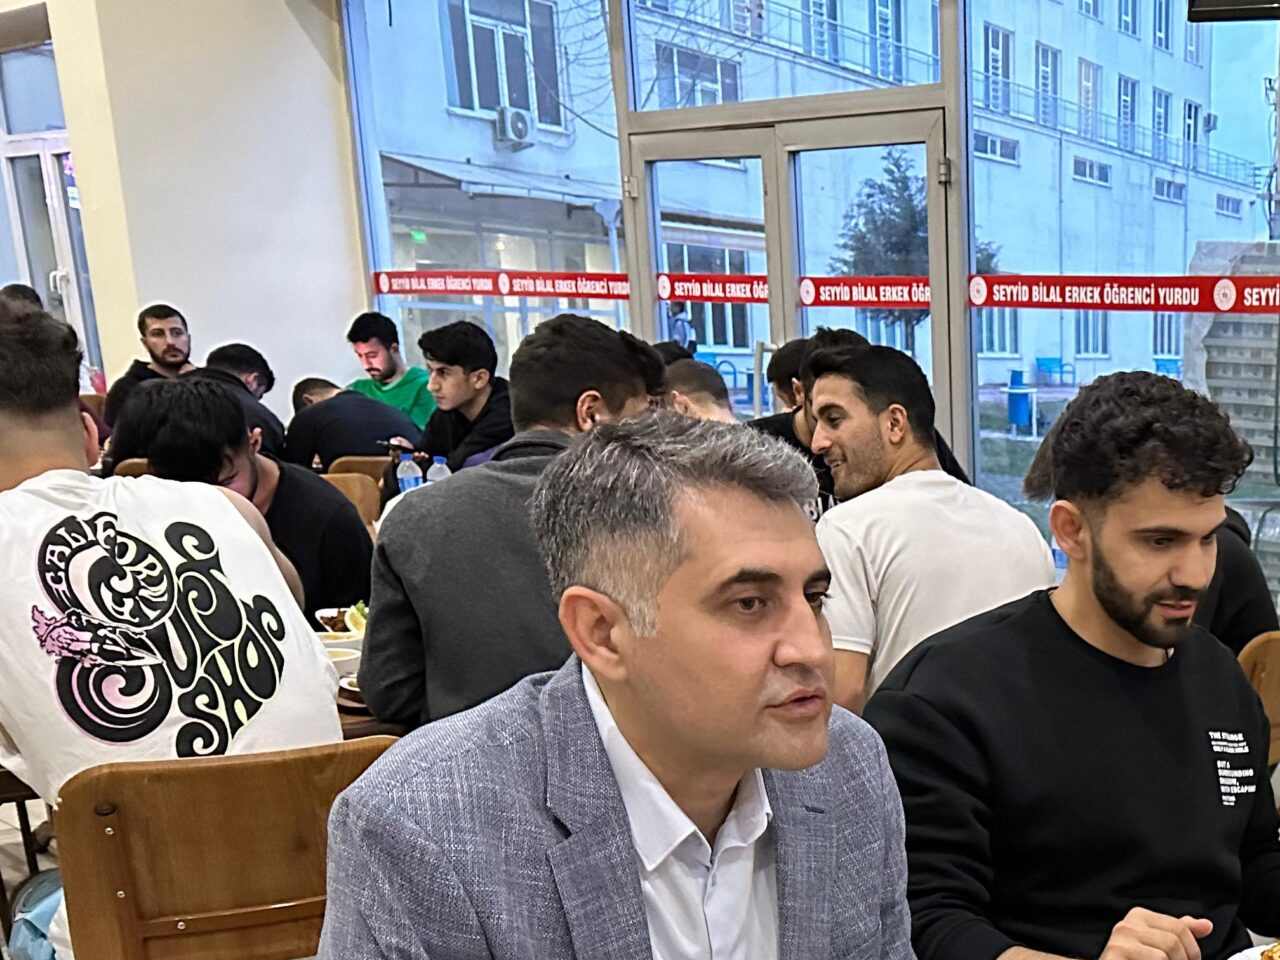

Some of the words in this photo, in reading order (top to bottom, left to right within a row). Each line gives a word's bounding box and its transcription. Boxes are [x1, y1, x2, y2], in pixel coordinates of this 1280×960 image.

[674, 279, 701, 296] SEYYİD
[702, 279, 725, 297] BİLAL
[725, 282, 752, 298] ERKEK
[819, 282, 850, 301] SEYYİD
[852, 282, 878, 302] BİLAL
[880, 286, 910, 303] ERKEK
[993, 281, 1029, 302] SEYYİD
[1032, 282, 1062, 303] BİLAL
[1065, 287, 1101, 304] ERKEK
[1103, 282, 1155, 305] ÖĞRENCİ
[1158, 287, 1199, 306] YURDU
